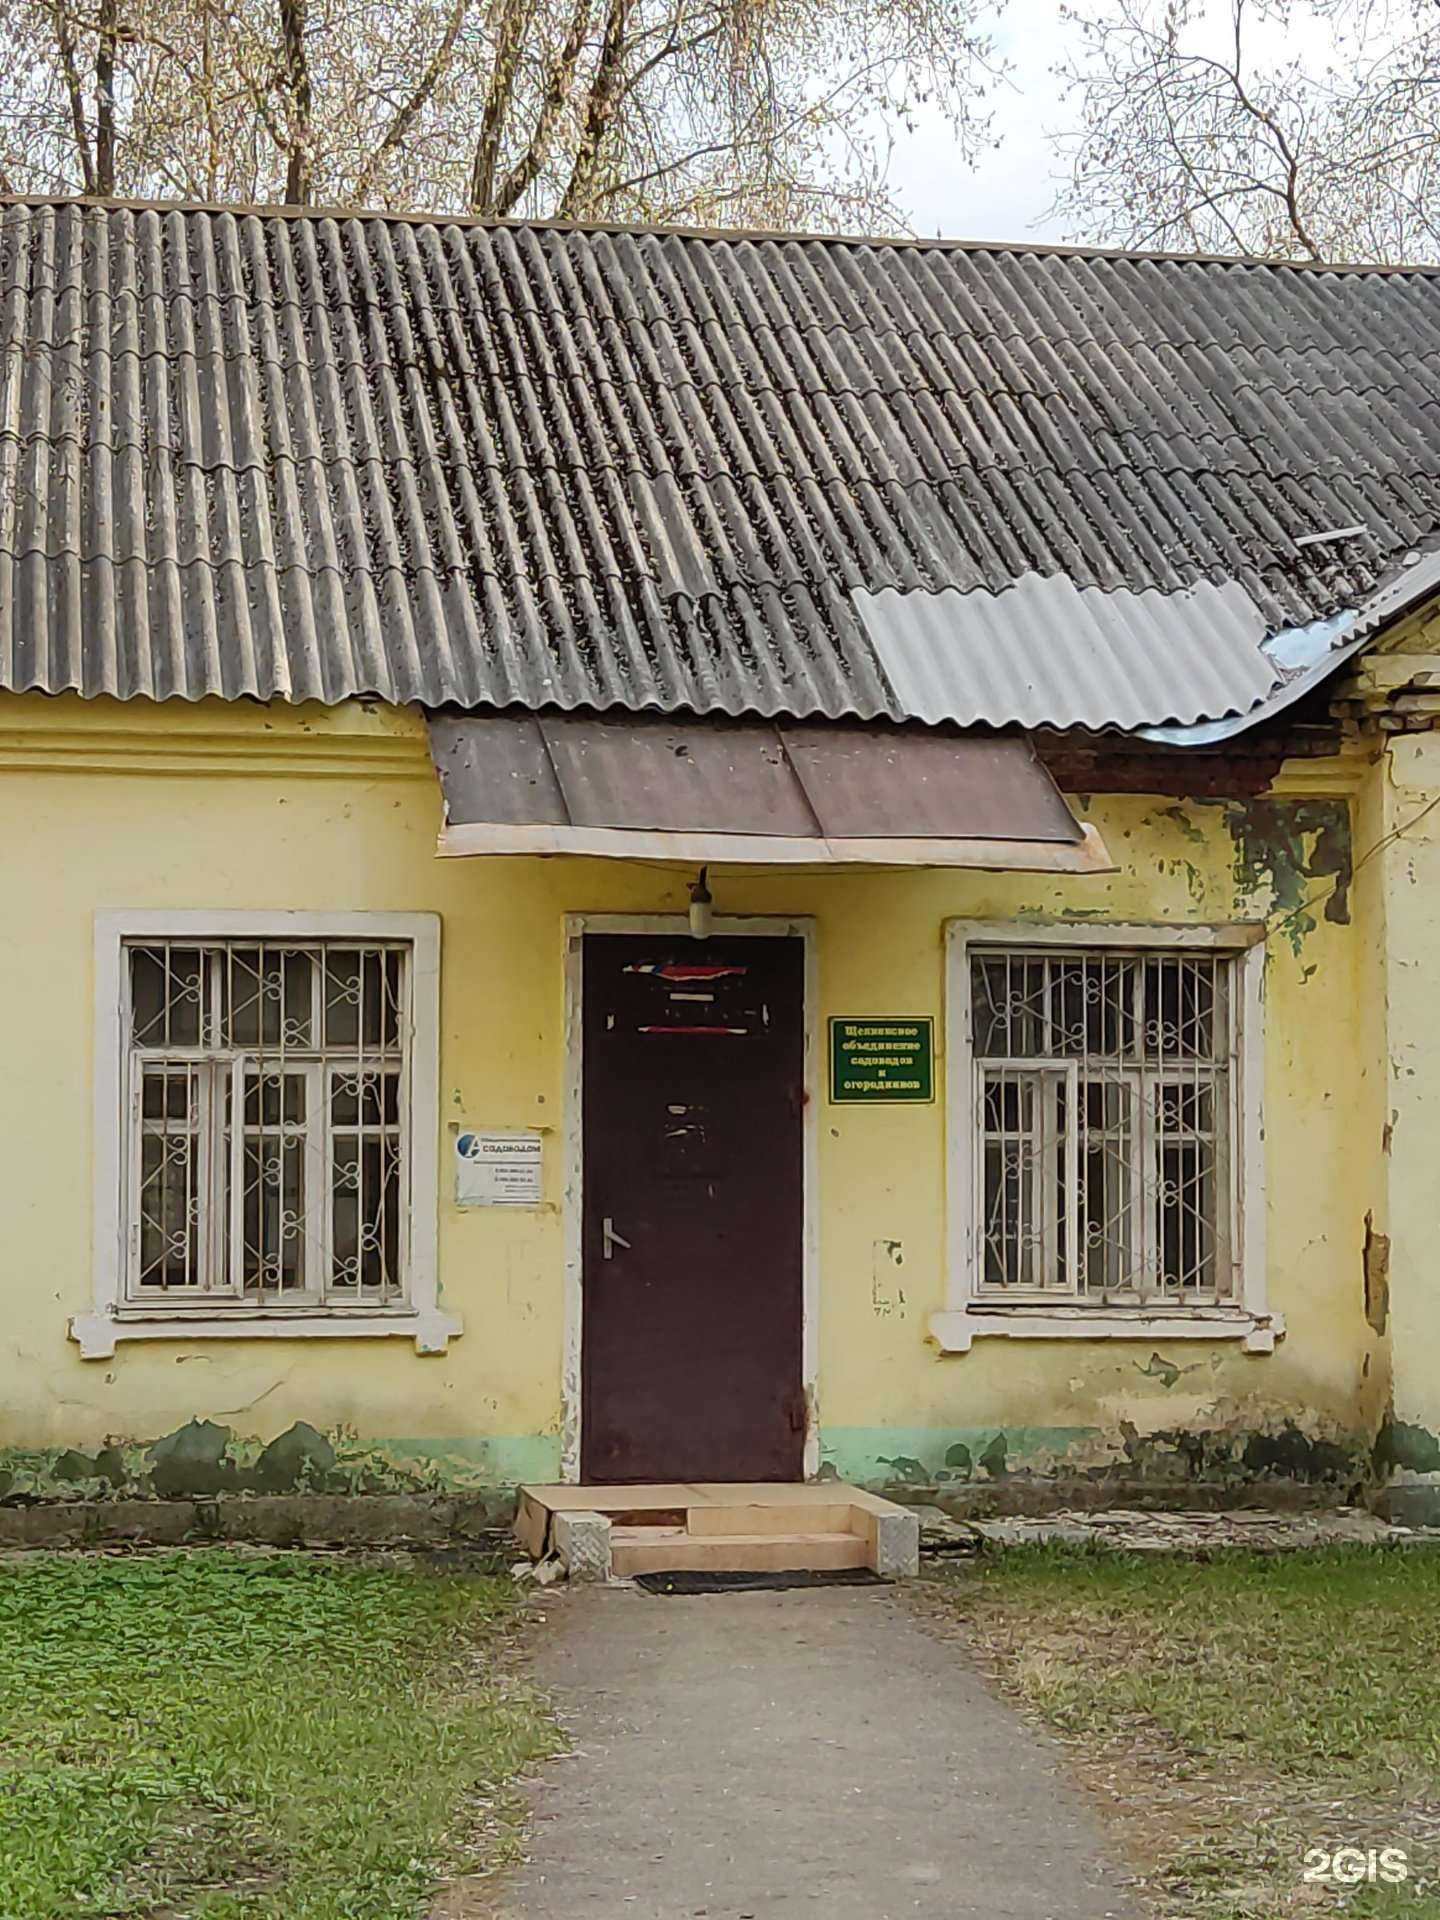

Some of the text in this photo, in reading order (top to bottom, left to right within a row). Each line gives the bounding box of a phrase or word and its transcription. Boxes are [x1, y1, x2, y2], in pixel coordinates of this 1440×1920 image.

[842, 1039, 921, 1052] объединение
[850, 1057, 914, 1067] садоводов
[878, 1069, 886, 1078] и
[843, 1080, 921, 1092] огородников
